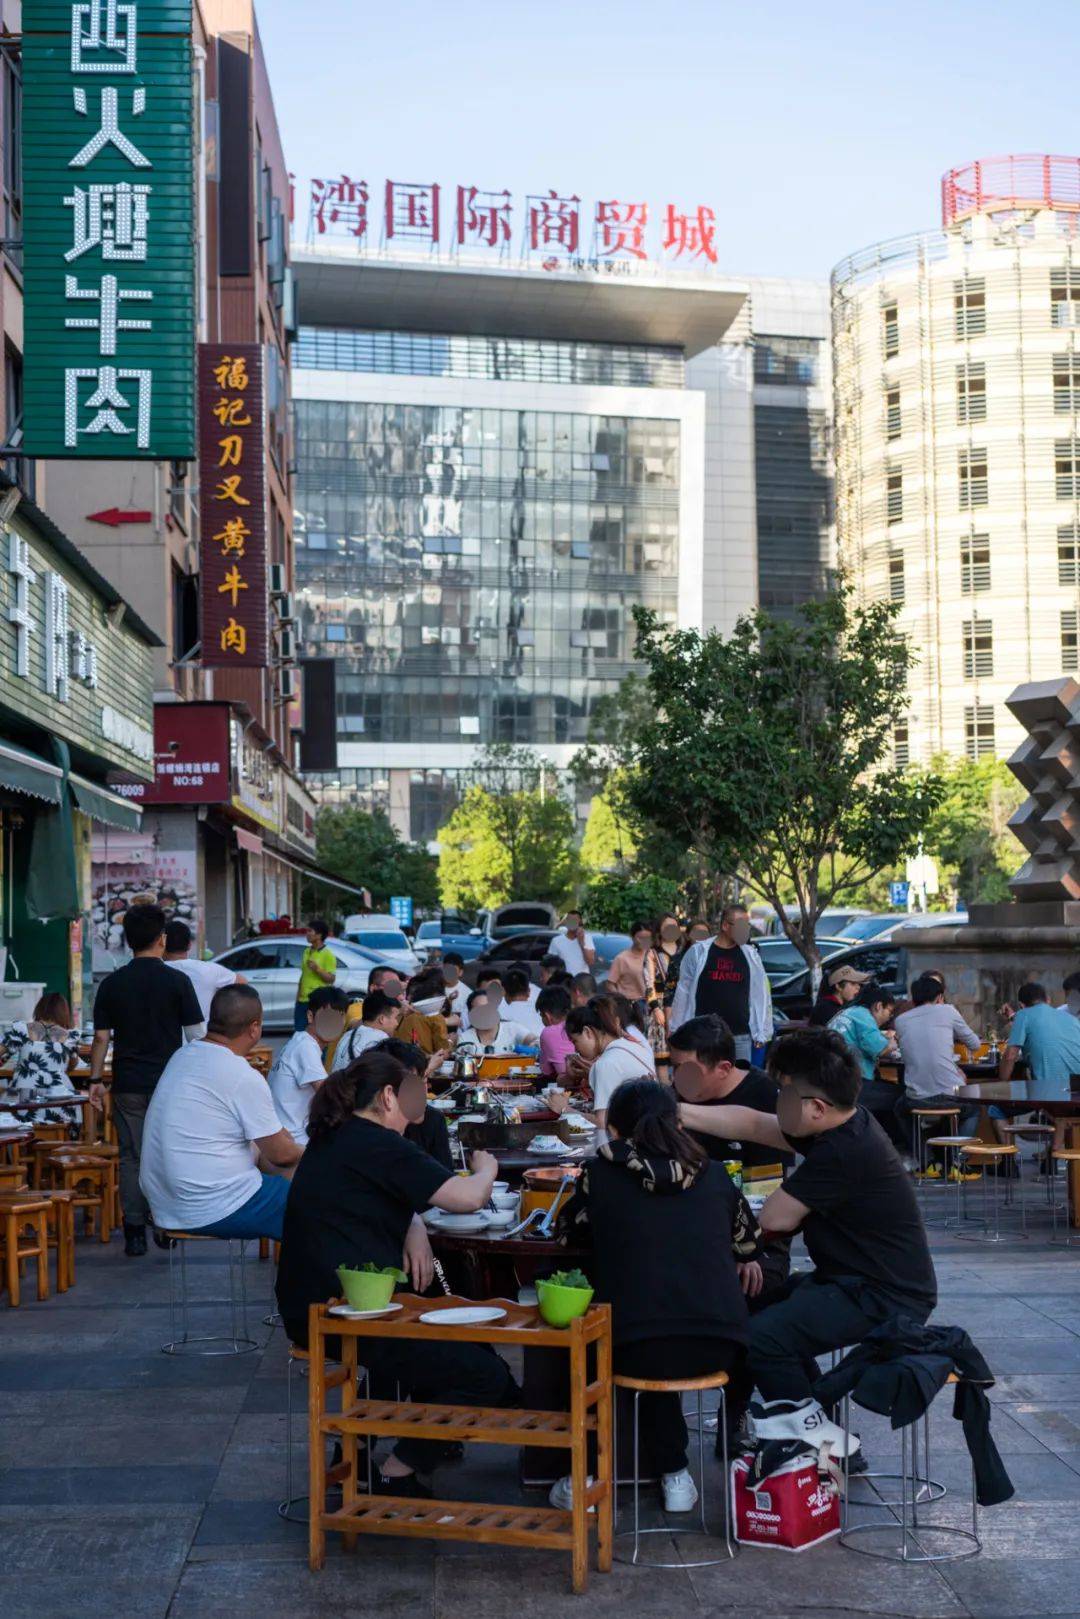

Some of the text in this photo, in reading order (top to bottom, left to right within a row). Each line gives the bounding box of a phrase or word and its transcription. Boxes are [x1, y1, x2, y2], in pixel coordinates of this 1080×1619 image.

[288, 173, 718, 264] 湾国际商贸城
[173, 775, 204, 787] NO:68
